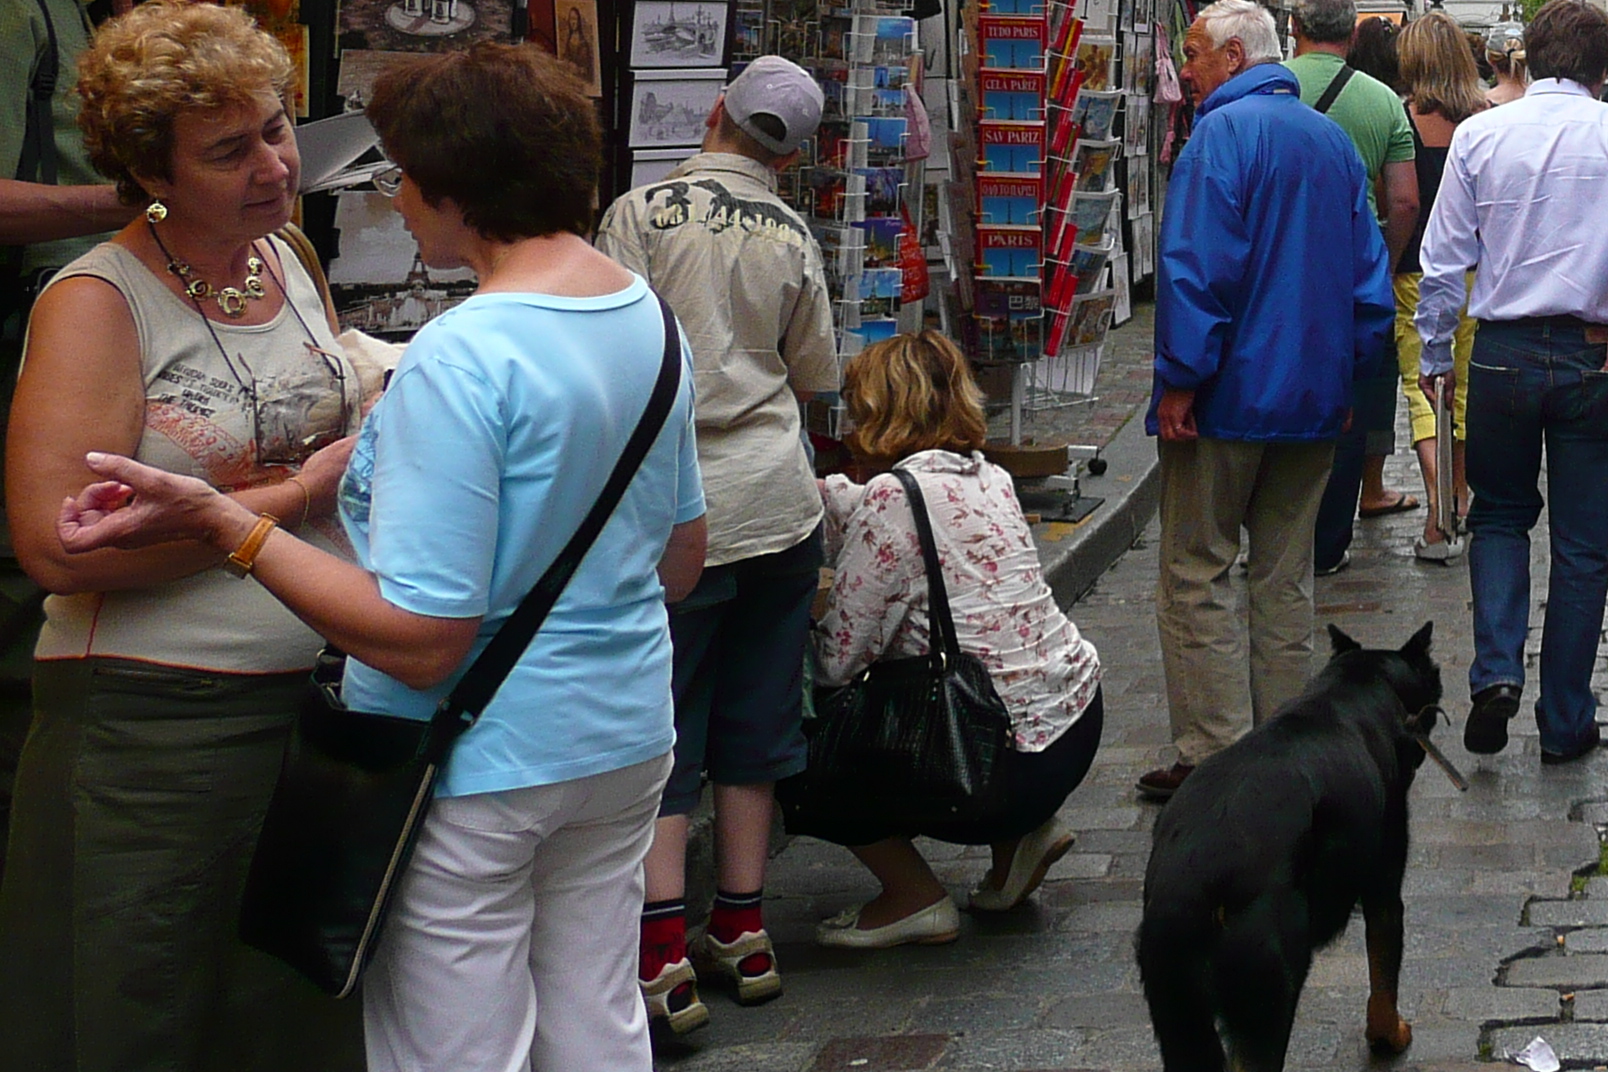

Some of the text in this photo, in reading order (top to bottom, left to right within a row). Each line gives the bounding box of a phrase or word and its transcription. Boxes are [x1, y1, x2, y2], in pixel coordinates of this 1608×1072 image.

[988, 26, 1038, 38] TUDO PARIS
[988, 234, 1033, 246] PARIS
